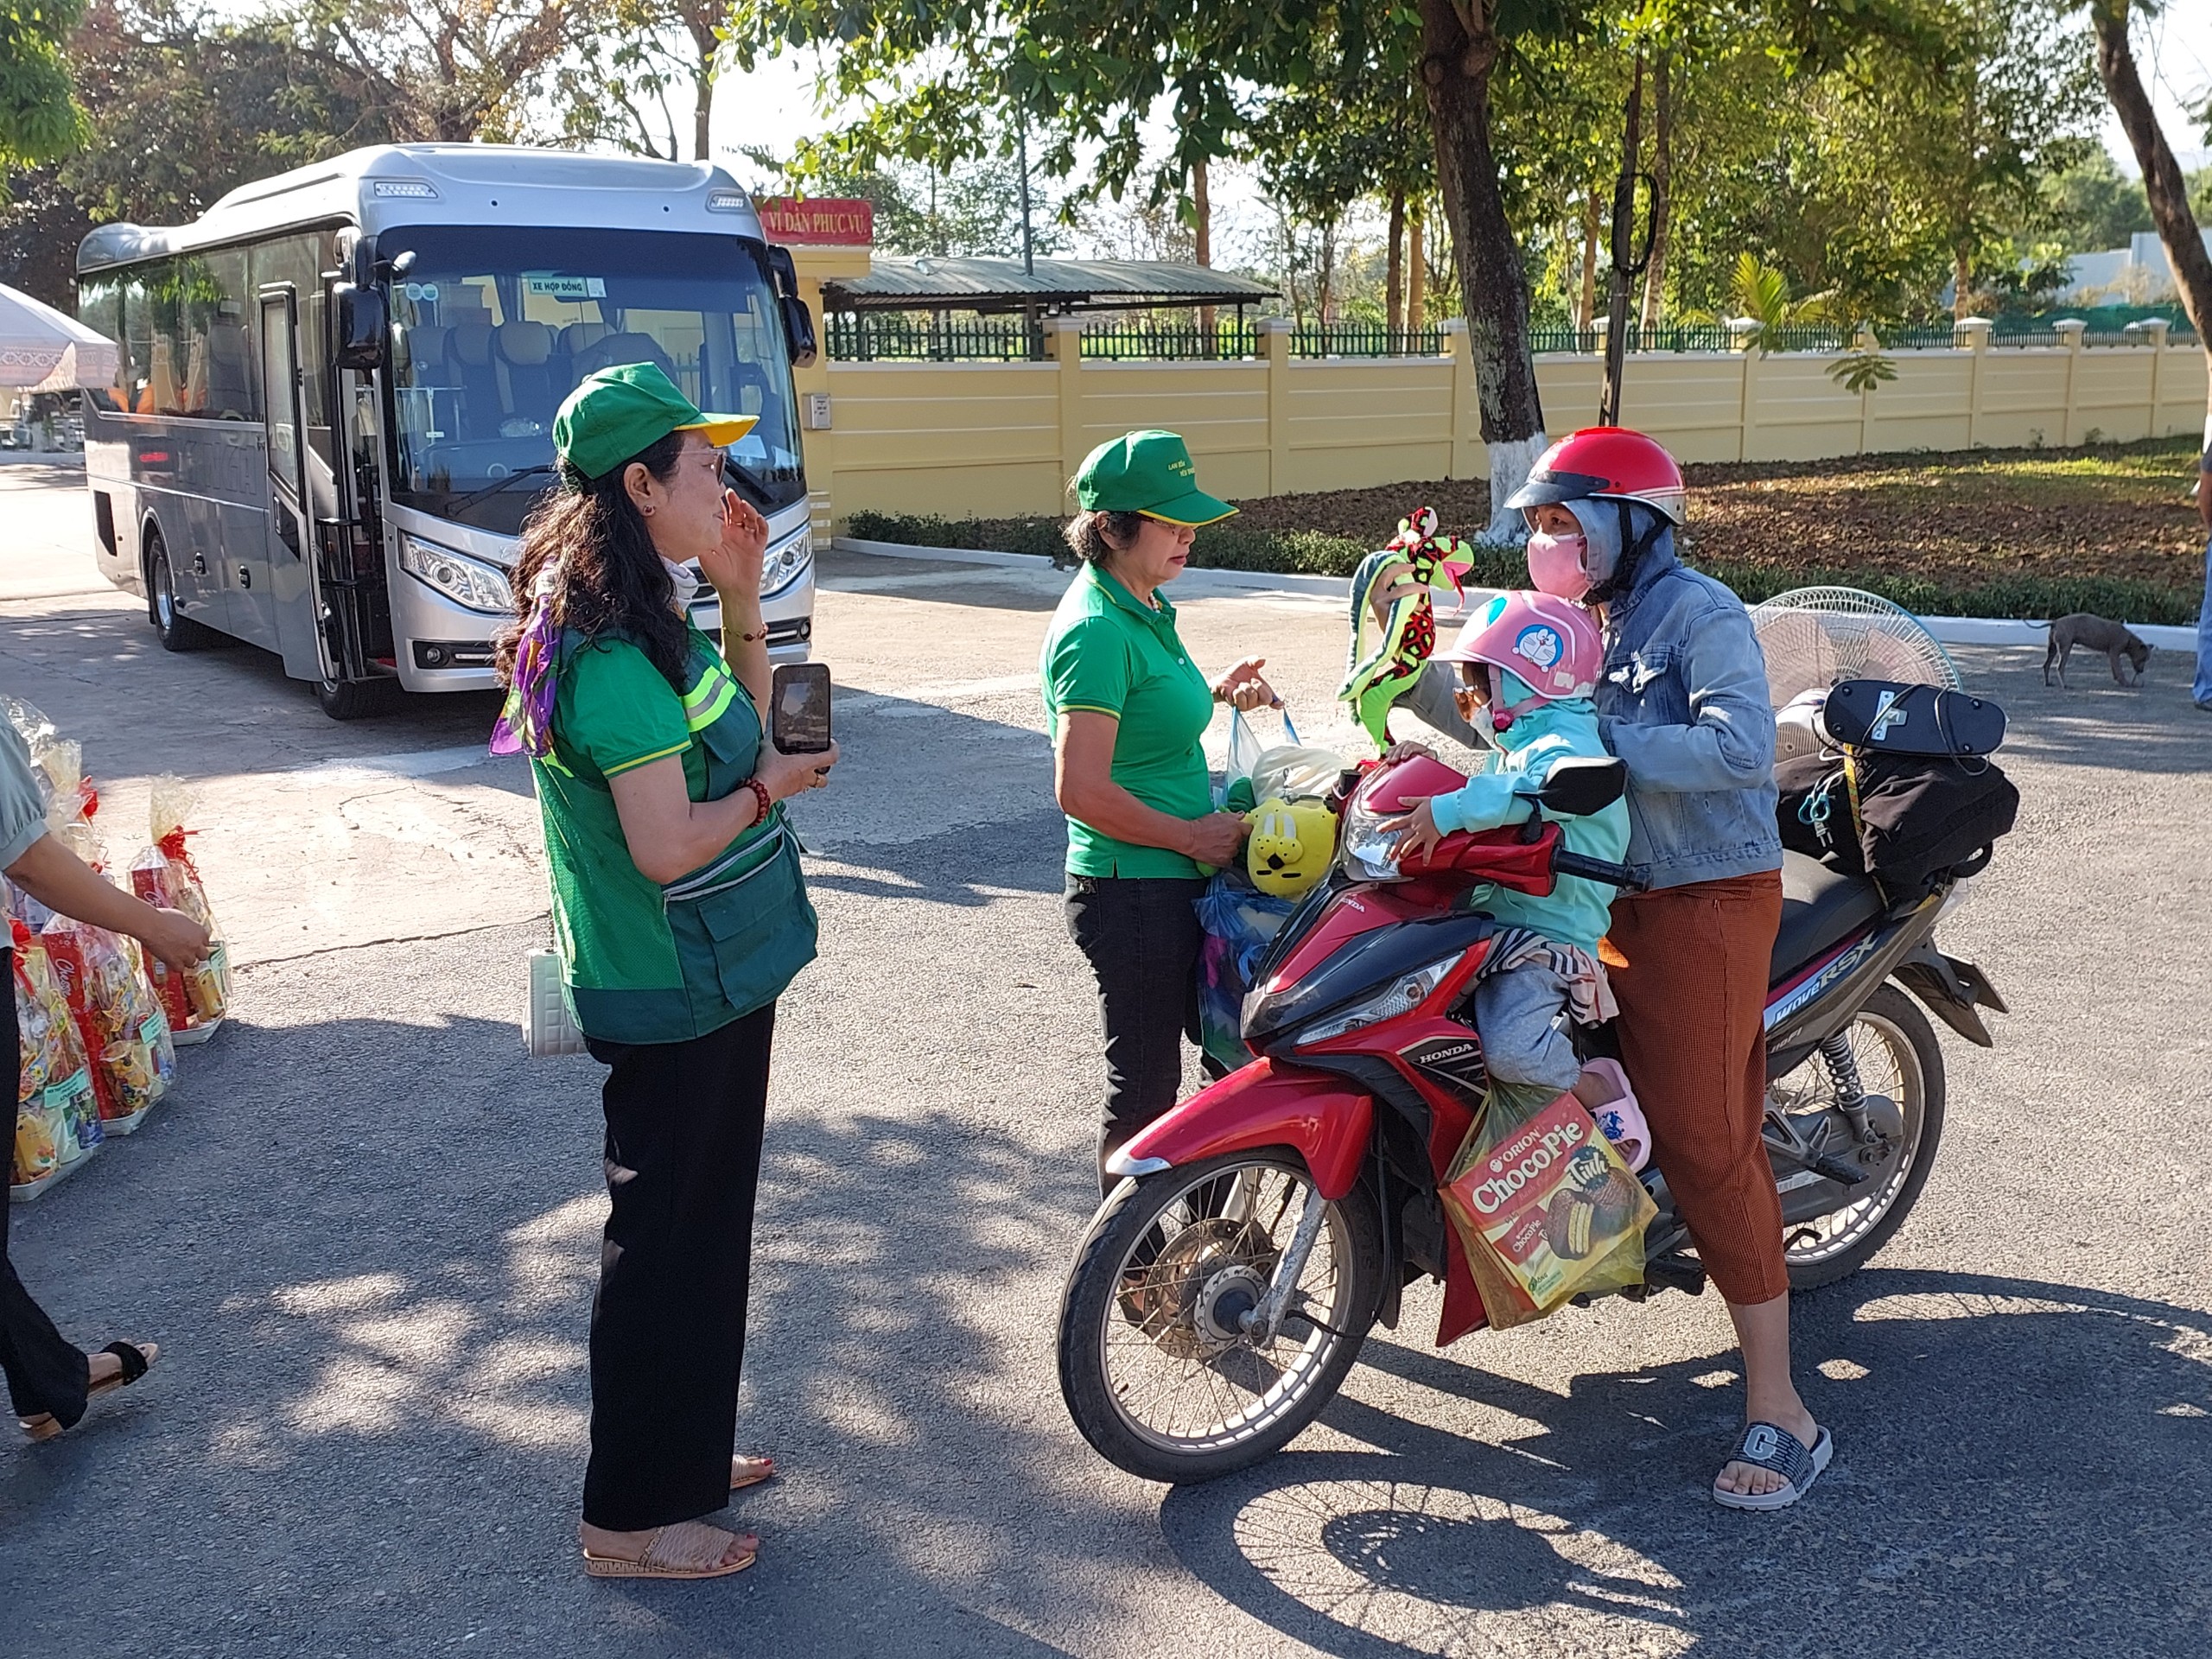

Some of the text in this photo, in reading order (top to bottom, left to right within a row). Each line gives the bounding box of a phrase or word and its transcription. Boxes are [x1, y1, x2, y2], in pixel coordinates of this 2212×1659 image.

[813, 213, 846, 235] PHỤC
[532, 282, 543, 290] XE
[1420, 1043, 1474, 1064] HONDA
[1503, 1129, 1541, 1162] ORION
